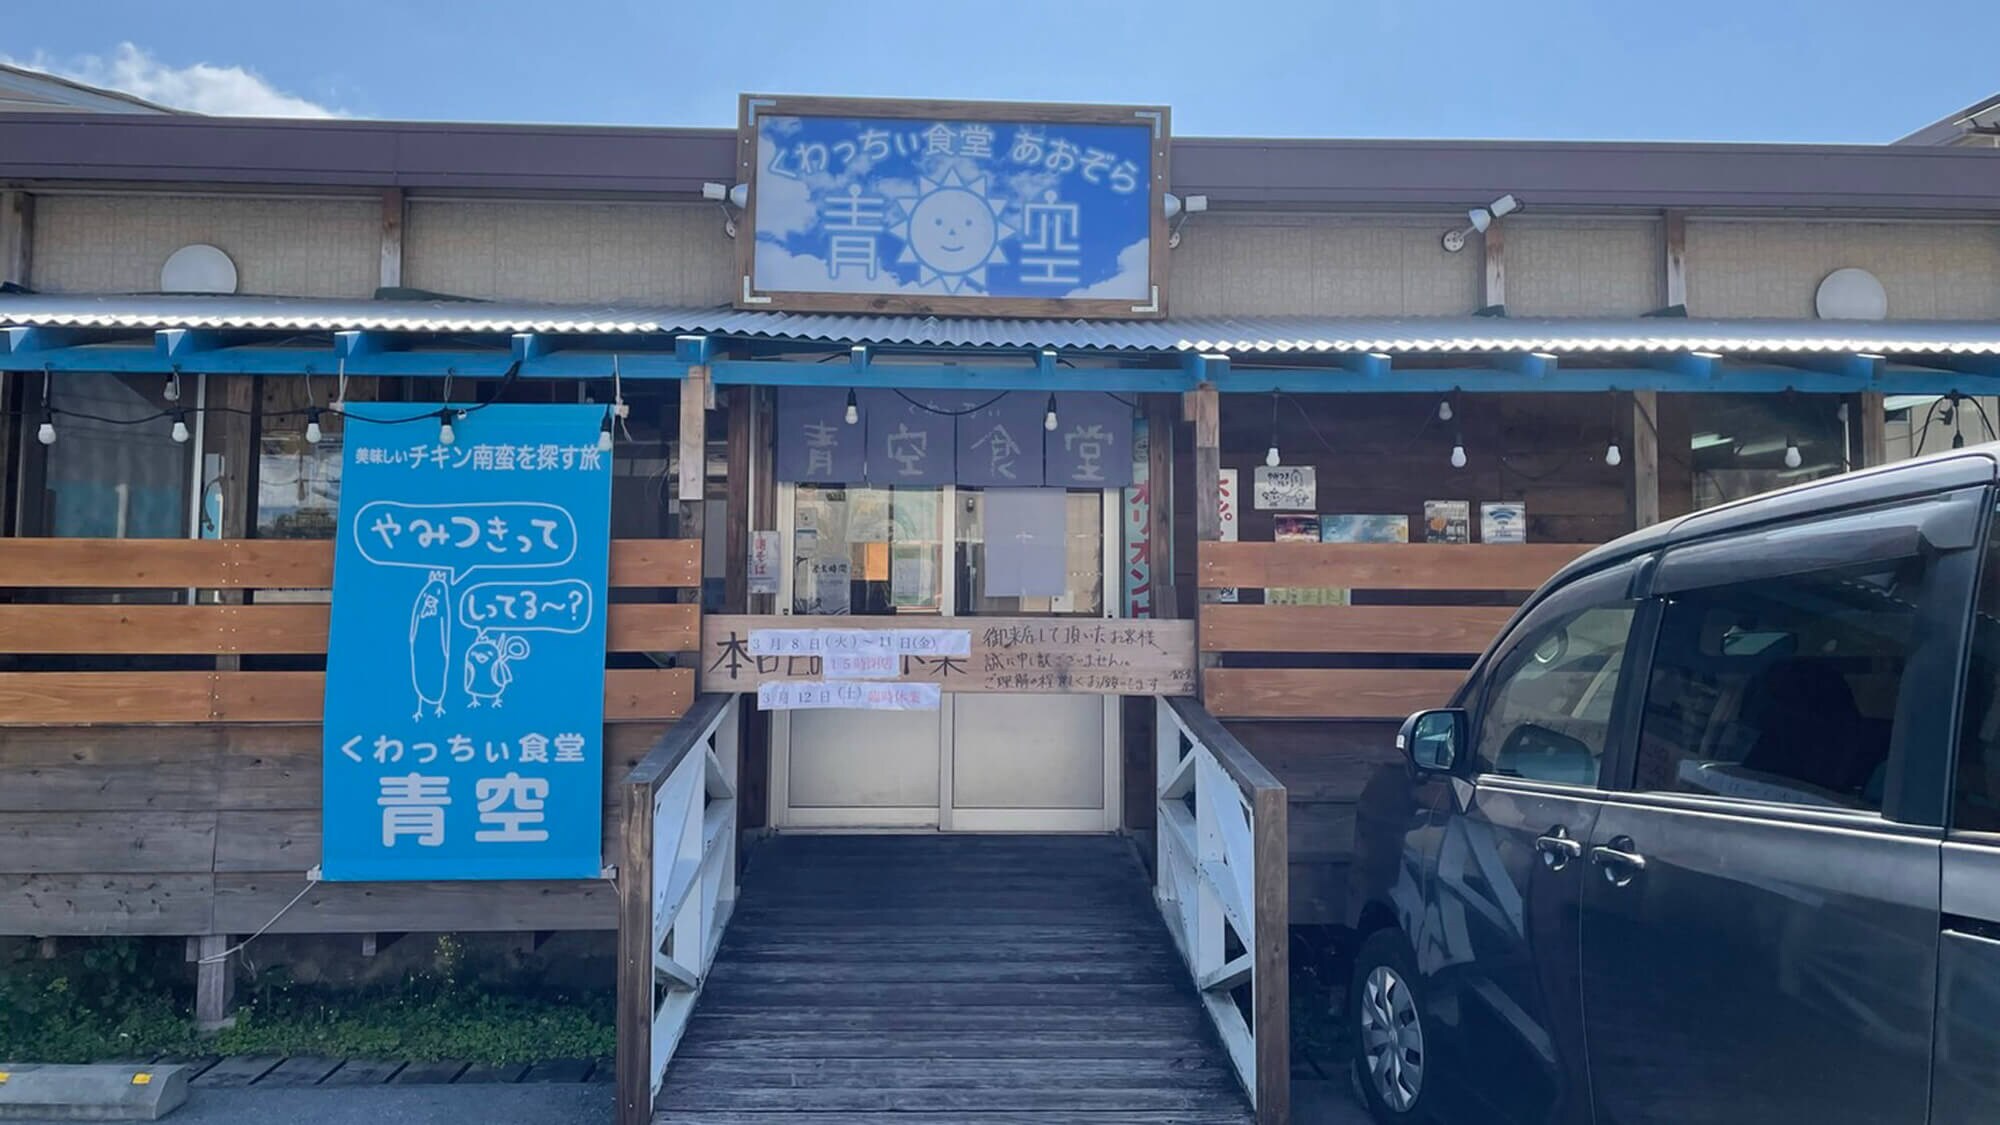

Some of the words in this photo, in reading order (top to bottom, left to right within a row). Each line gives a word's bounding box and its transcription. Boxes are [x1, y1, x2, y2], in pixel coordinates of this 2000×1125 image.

[1011, 131, 1138, 194] あおぞら
[355, 443, 602, 472] 美味しいチキン南蛮を探す旅
[371, 513, 559, 553] やみつきって
[377, 772, 550, 848] 青空
